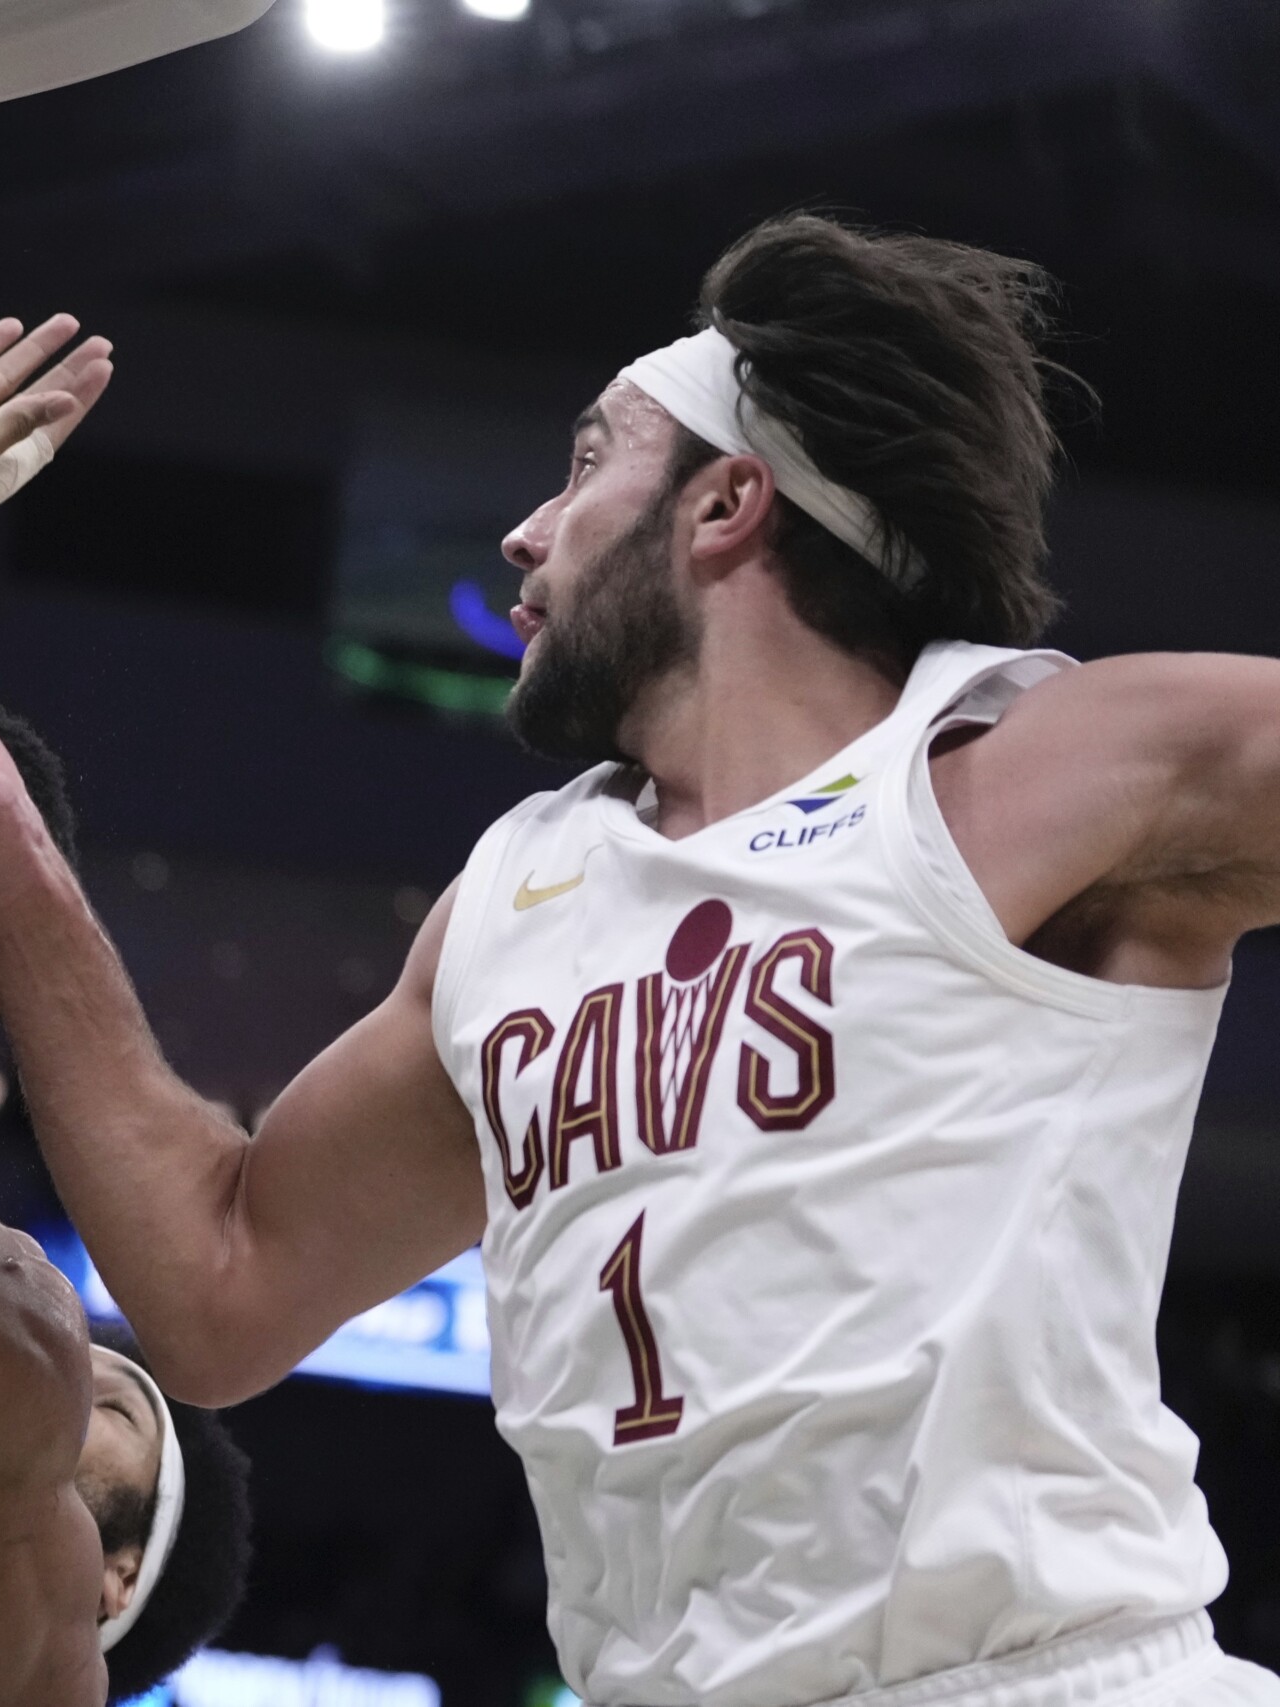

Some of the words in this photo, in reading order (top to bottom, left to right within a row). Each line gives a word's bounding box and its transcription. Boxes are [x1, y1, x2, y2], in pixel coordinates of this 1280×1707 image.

[749, 804, 867, 852] CLIFFS
[481, 906, 836, 1211] CAVS
[599, 1208, 685, 1447] 1
